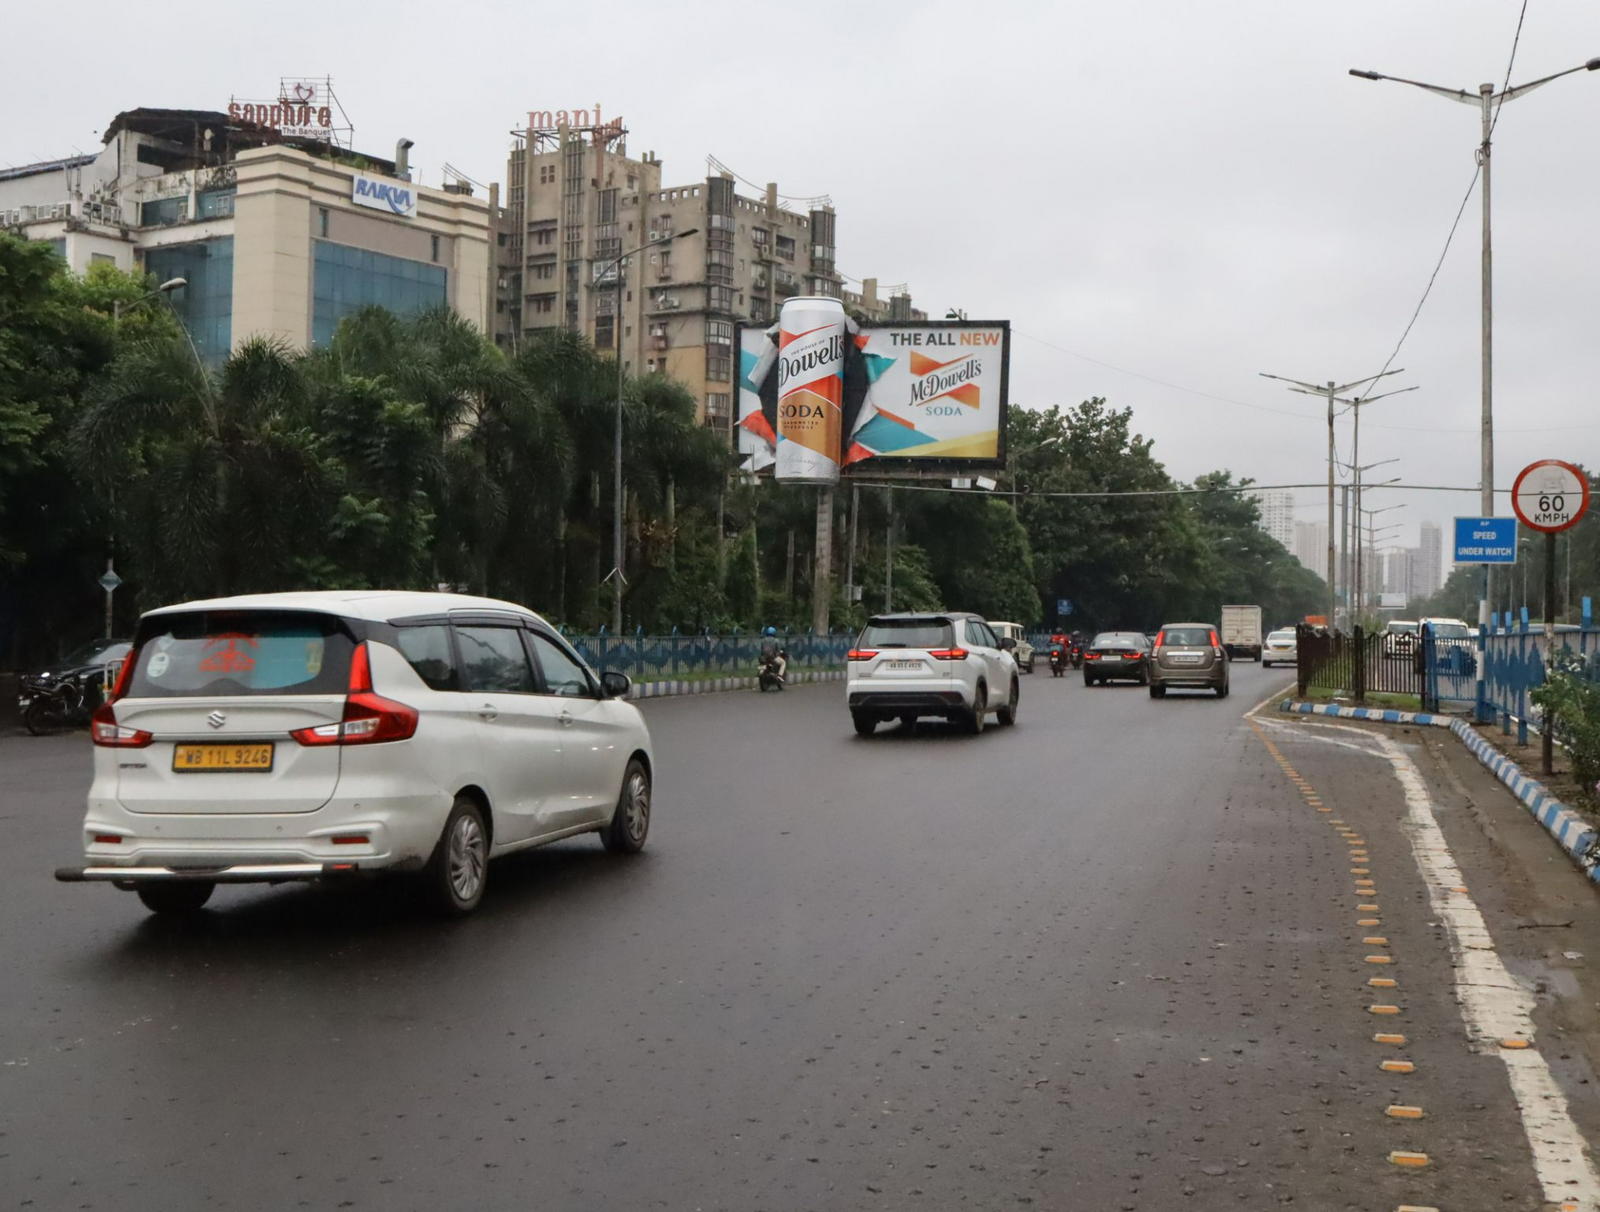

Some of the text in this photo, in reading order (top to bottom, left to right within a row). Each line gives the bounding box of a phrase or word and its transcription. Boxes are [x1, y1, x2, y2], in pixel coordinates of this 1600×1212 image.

[228, 98, 331, 133] sapphire
[527, 103, 602, 129] mani
[282, 127, 331, 137] The Banquet
[355, 179, 412, 212] RAIKVA
[890, 332, 1000, 346] THE ALL NEW
[909, 359, 982, 406] McDowell's
[779, 404, 824, 419] SODA
[925, 406, 963, 416] SODA
[1539, 496, 1564, 512] 60
[1534, 513, 1569, 523] KMPH
[1473, 531, 1497, 540] SPEED
[1458, 547, 1512, 557] UNDER WATCH
[186, 750, 202, 764] WB
[235, 750, 268, 763] 9246
